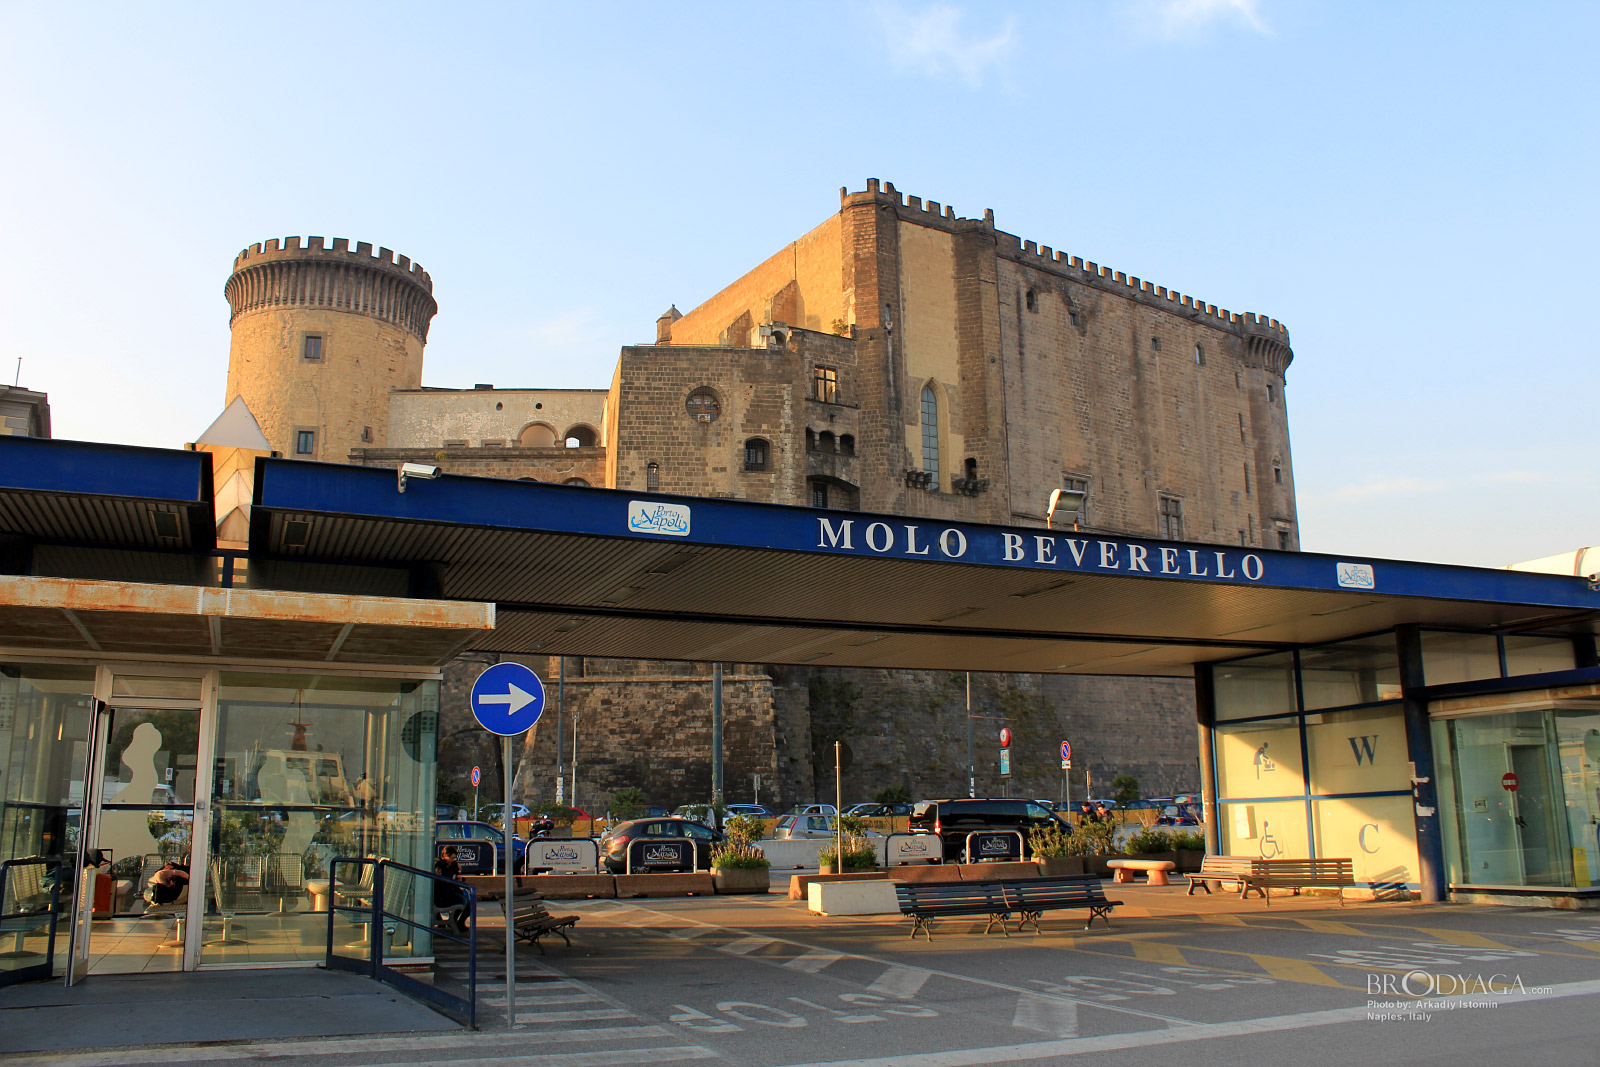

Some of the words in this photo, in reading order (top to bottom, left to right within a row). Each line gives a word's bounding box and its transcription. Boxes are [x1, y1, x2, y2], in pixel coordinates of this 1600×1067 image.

[640, 508, 684, 531] Napoli
[656, 505, 678, 517] Porto
[816, 517, 968, 558] MOLO
[1001, 532, 1264, 580] BEVERELLO
